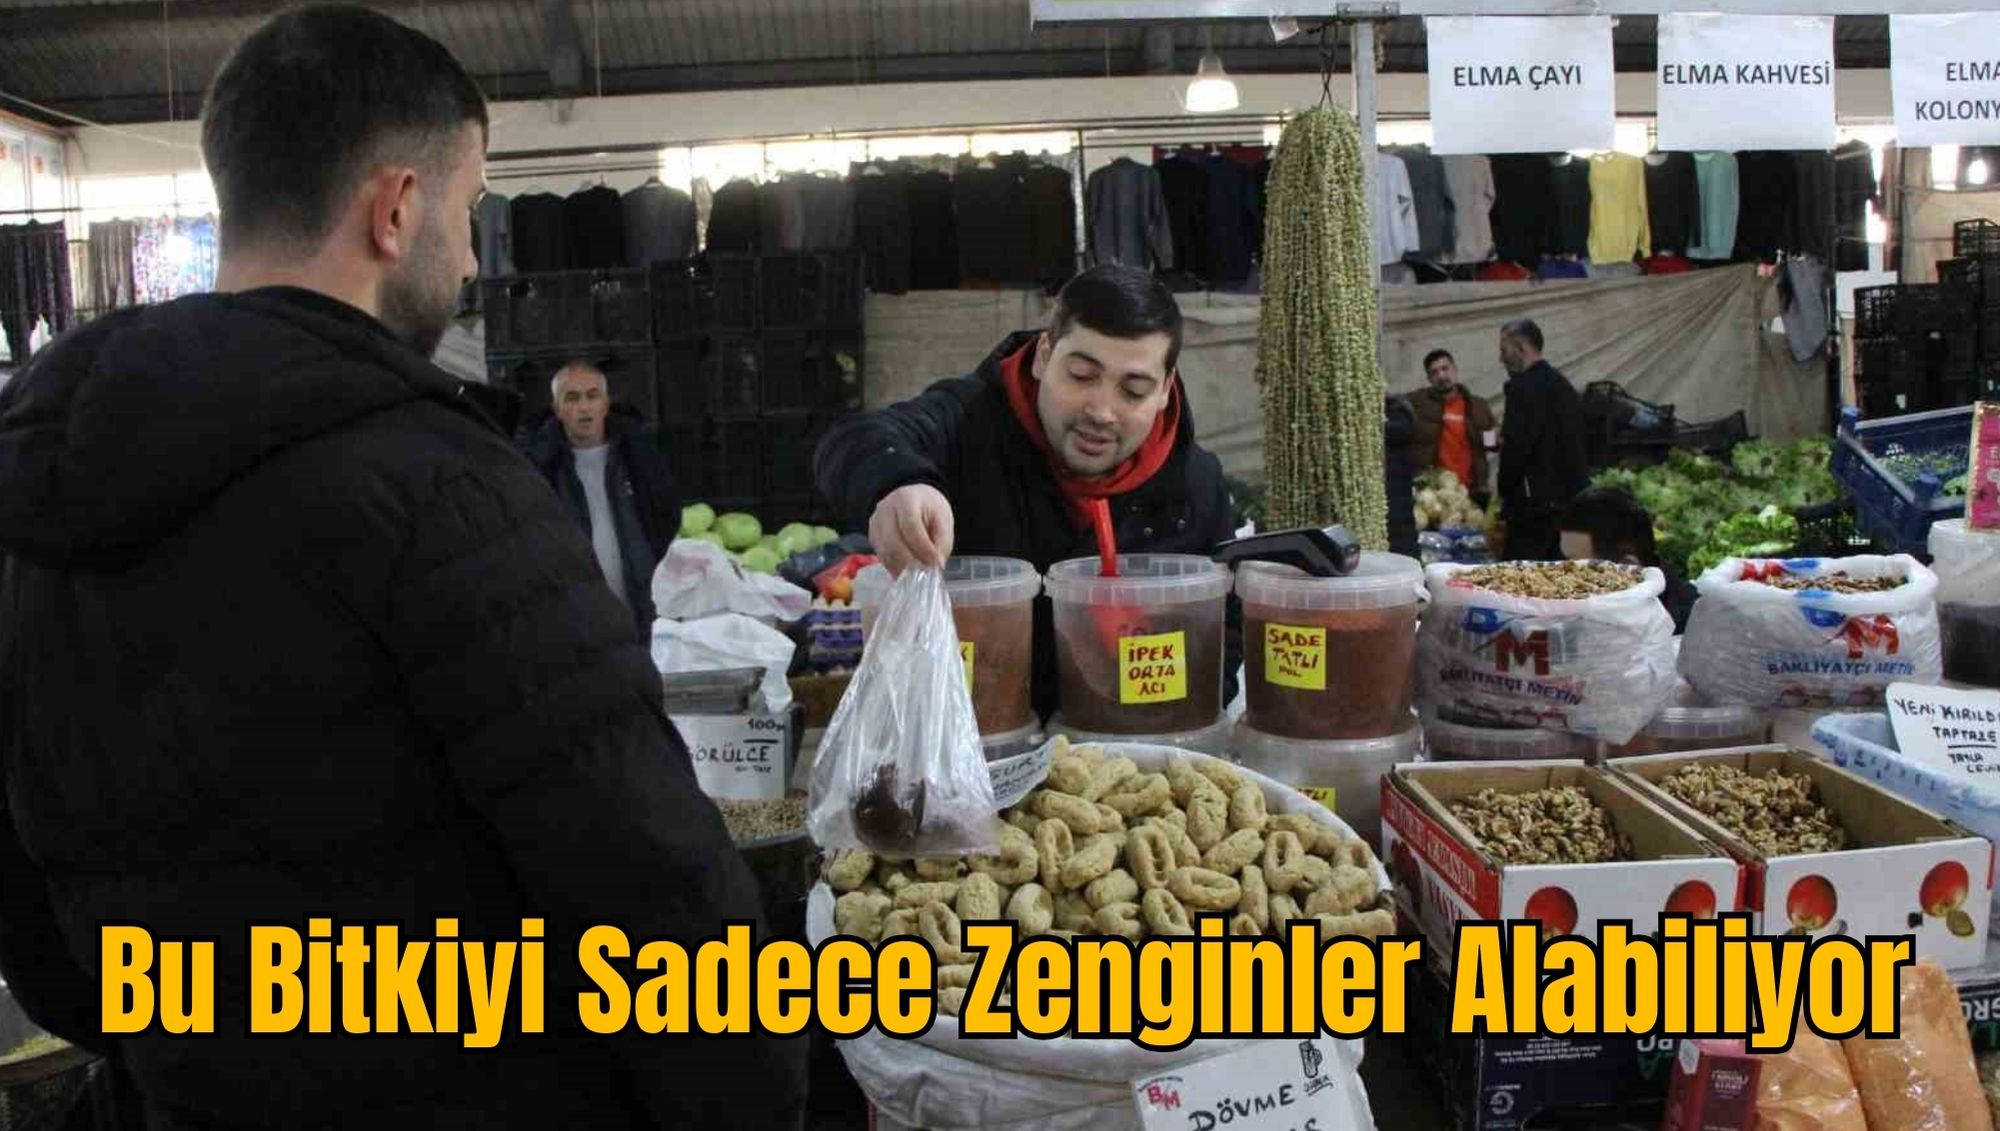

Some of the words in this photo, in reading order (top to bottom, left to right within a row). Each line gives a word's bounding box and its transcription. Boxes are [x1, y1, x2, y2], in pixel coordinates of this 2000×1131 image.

[1454, 66, 1521, 87] ELMA
[1528, 65, 1582, 91] ÇAYI
[1663, 64, 1727, 85] ELMA
[1735, 62, 1830, 86] KAHVESİ
[1267, 629, 1322, 647] SADE
[1127, 642, 1174, 663] İPEK
[1271, 648, 1319, 669] TATLI
[1126, 664, 1176, 681] ORTA
[1138, 681, 1166, 696] ACI
[1939, 704, 2000, 723] KIRILD
[690, 742, 770, 763] ÖRÜLCE
[1188, 1083, 1296, 1131] DÖVME
